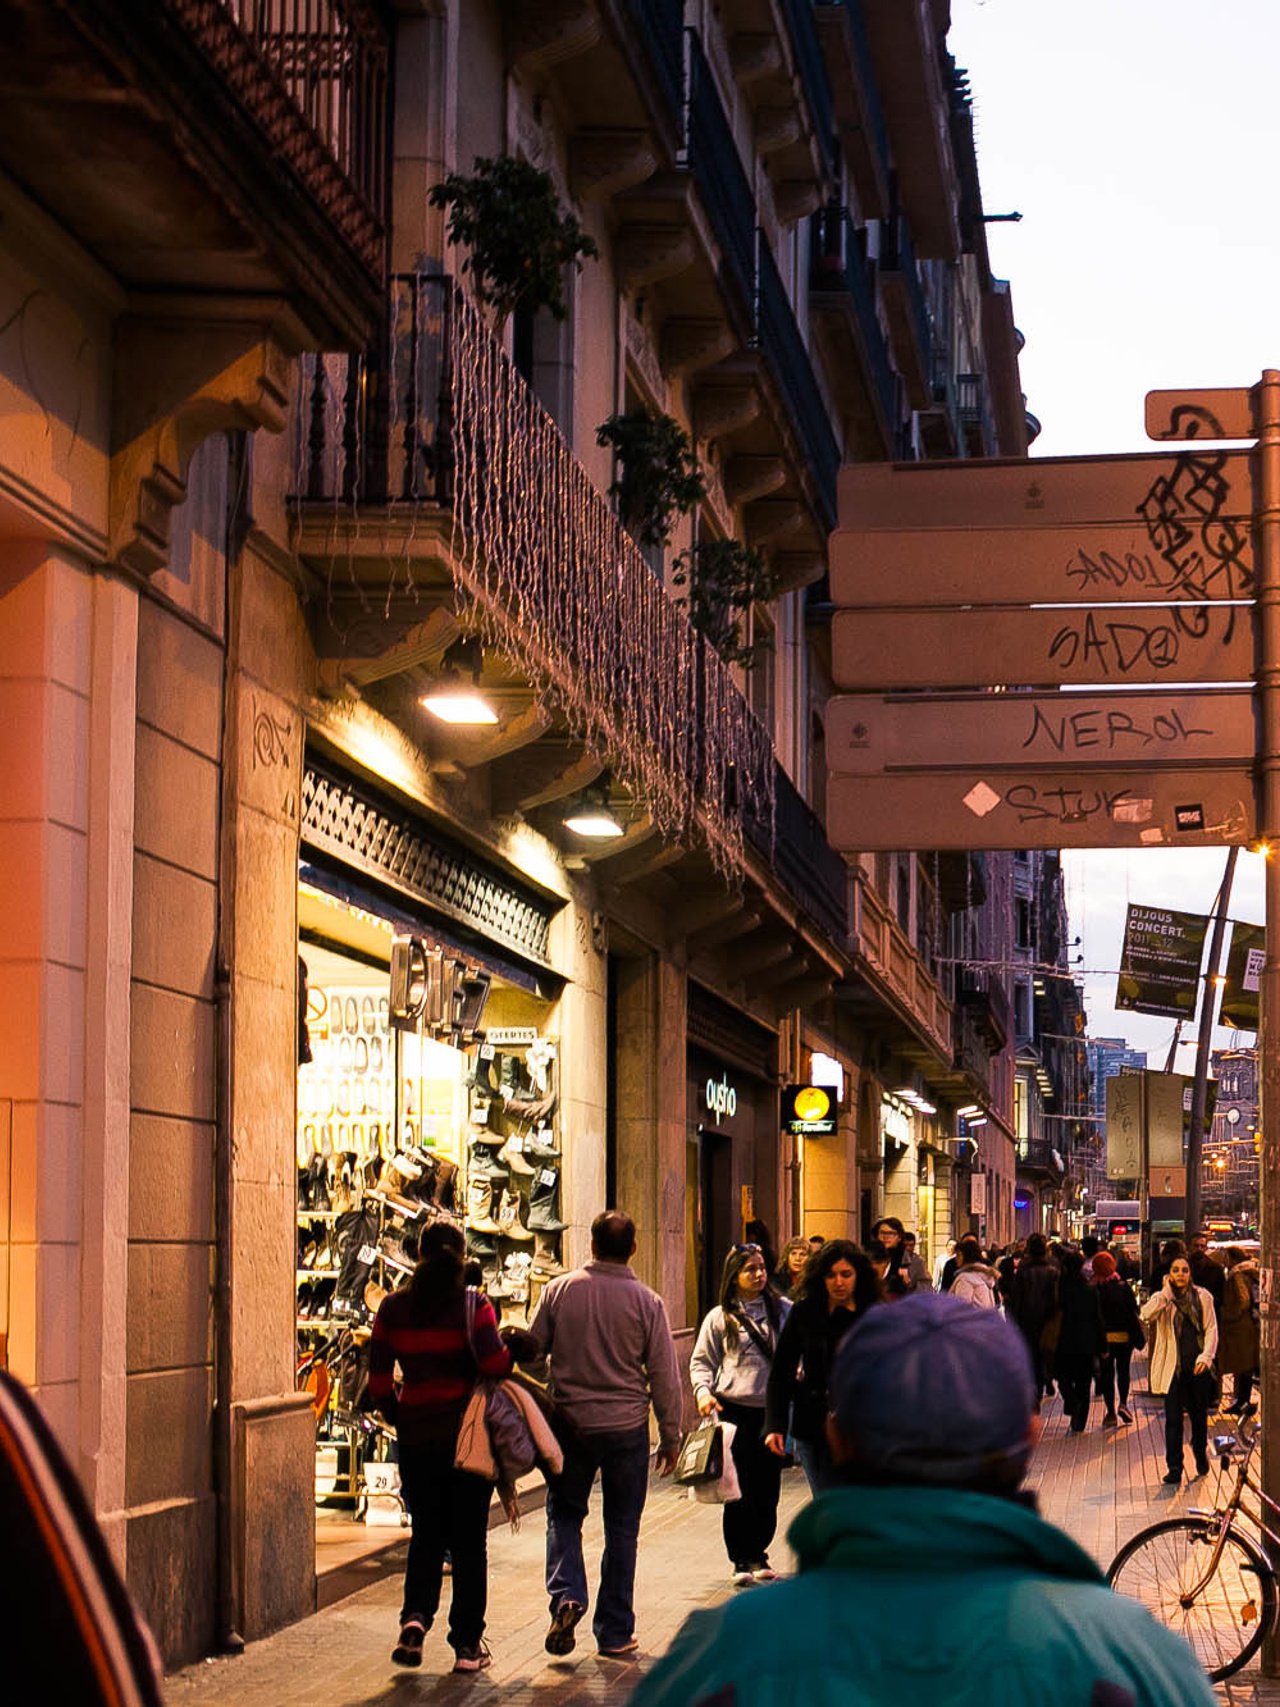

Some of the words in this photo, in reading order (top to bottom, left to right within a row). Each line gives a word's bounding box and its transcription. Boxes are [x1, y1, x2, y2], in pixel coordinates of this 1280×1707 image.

[1131, 908, 1173, 923] DIJOUS
[1129, 920, 1186, 938] CONCERT.
[706, 1071, 737, 1126] oysho
